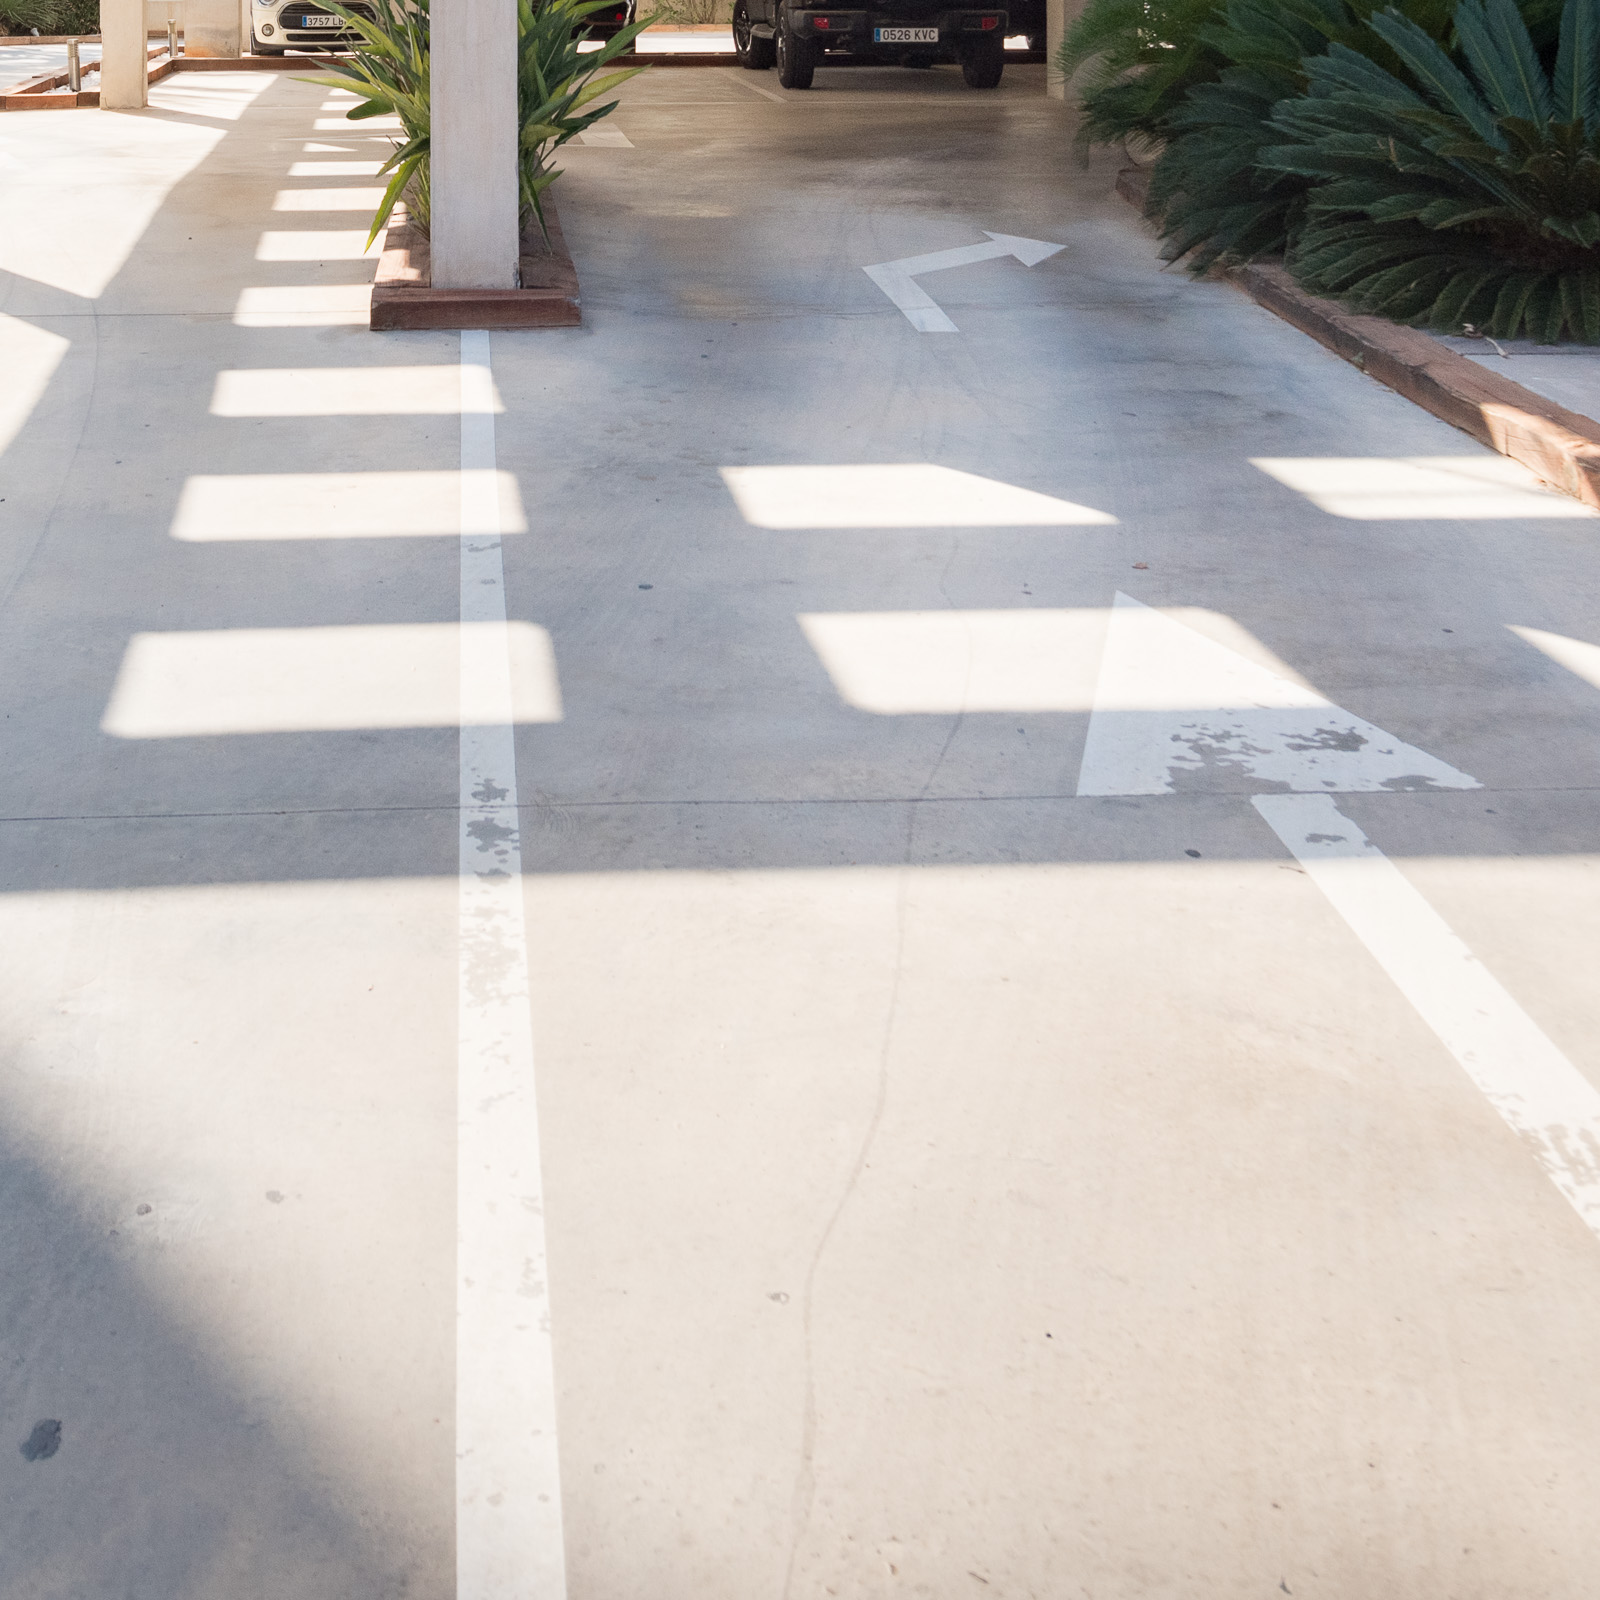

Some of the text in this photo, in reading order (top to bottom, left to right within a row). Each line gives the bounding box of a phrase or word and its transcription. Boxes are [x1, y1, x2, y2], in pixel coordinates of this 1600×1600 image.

[307, 17, 348, 26] 3757 LB
[882, 29, 936, 41] 0526 KVC
